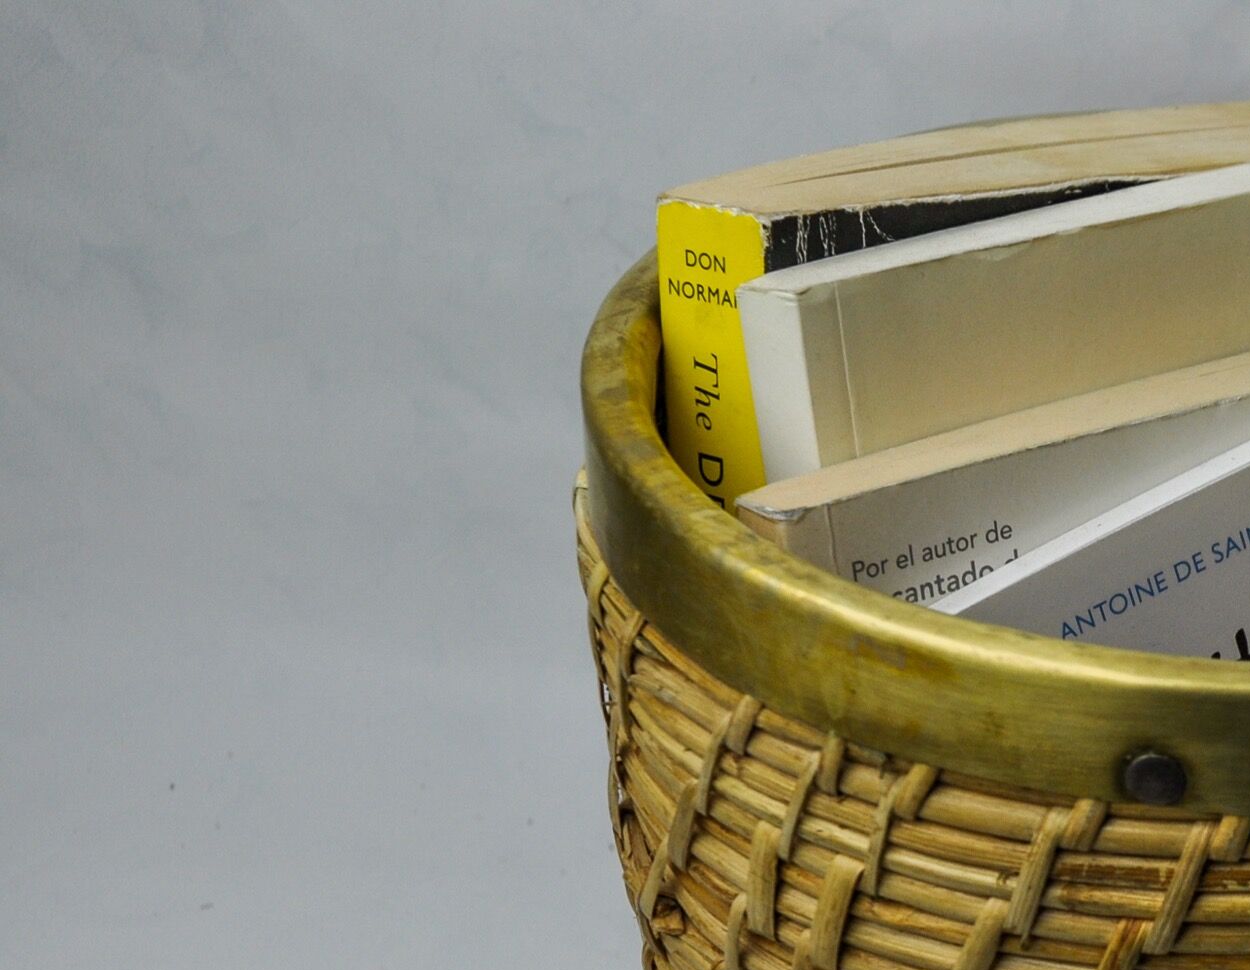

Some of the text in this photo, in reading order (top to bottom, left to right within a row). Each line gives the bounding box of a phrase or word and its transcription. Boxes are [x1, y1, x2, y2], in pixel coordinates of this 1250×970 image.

[685, 249, 726, 274] DON
[693, 353, 720, 431] The
[851, 557, 888, 582] Por
[896, 544, 915, 569] el
[922, 532, 978, 562] autor
[985, 520, 1013, 544] de
[1060, 571, 1169, 641] ANTOINE
[1174, 551, 1207, 583] DE
